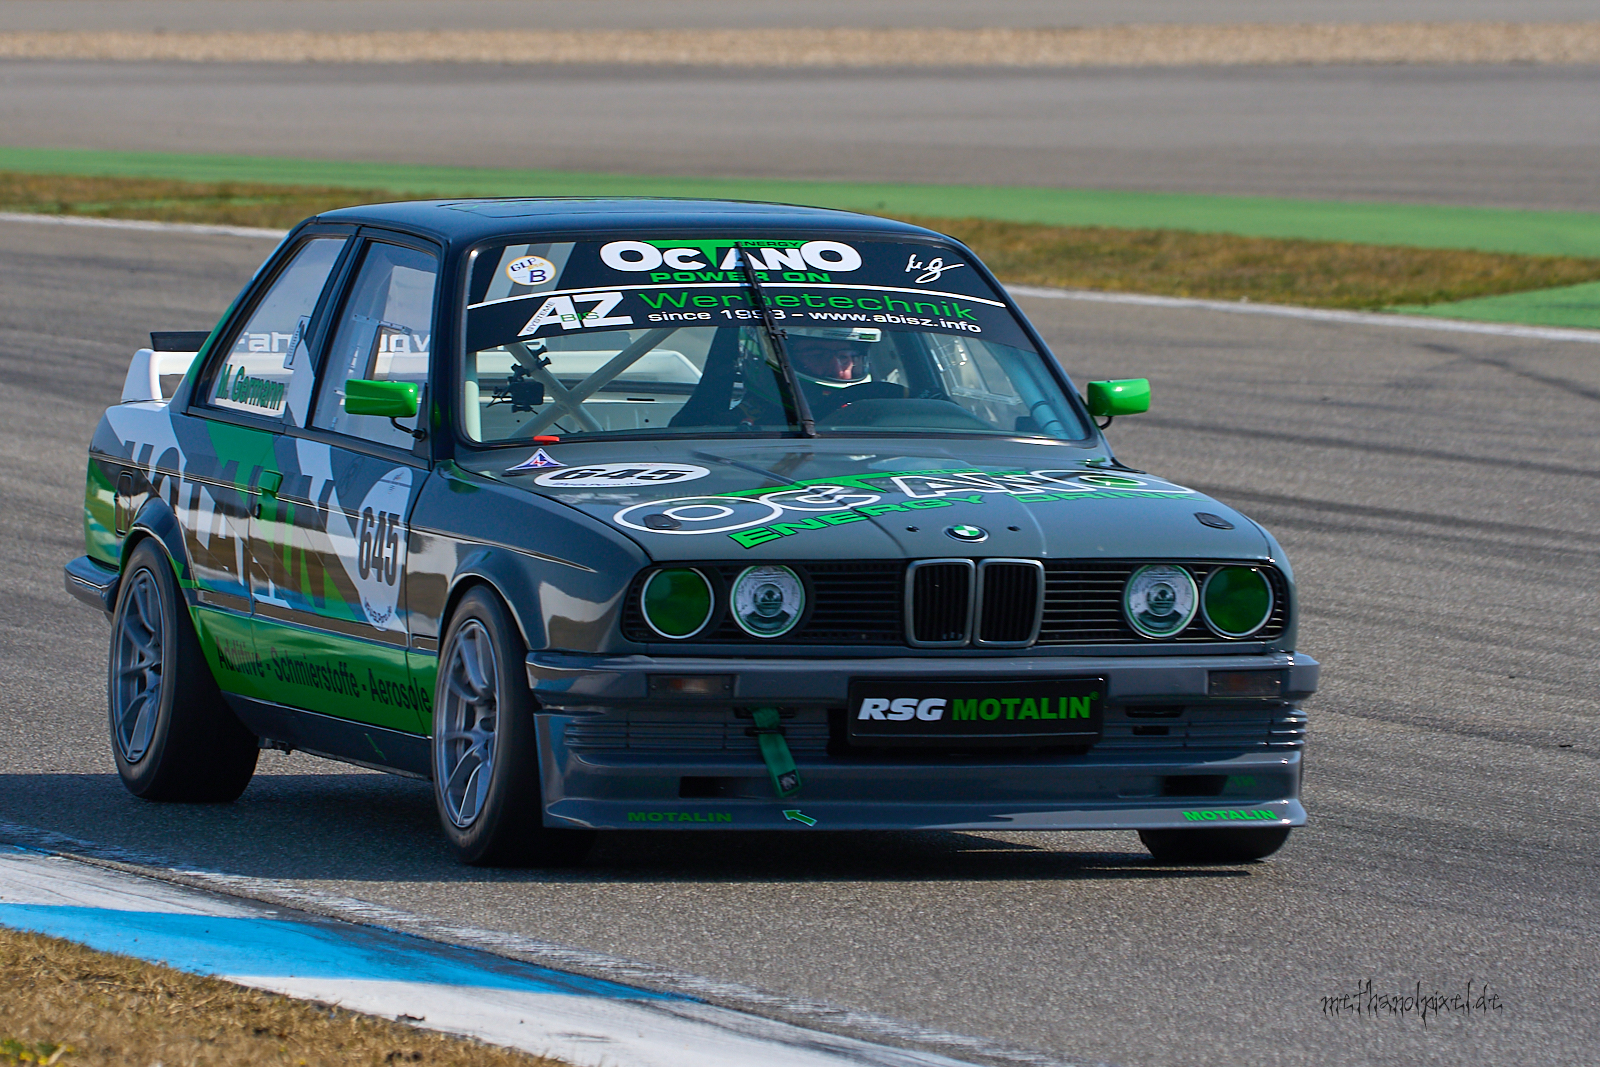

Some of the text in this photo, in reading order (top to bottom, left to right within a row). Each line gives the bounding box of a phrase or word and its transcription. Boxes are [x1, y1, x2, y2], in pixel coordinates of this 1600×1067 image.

[510, 257, 536, 272] GLP
[530, 269, 547, 283] B
[650, 271, 831, 283] POWER ON
[638, 291, 977, 321] Werbetechnik
[648, 310, 711, 322] since
[720, 309, 787, 322] 1993
[808, 312, 981, 333] www.abisz.info
[231, 365, 285, 411] Germann
[549, 469, 694, 480] 645
[728, 495, 984, 549] ENERGY
[358, 506, 401, 586] 645
[215, 636, 265, 678] Additive
[271, 646, 360, 698] Schmierstoffe
[368, 668, 432, 713] Aerosole
[857, 698, 947, 721] RSG
[627, 812, 732, 822] MOTALIN
[1182, 810, 1278, 821] MOTALIN
